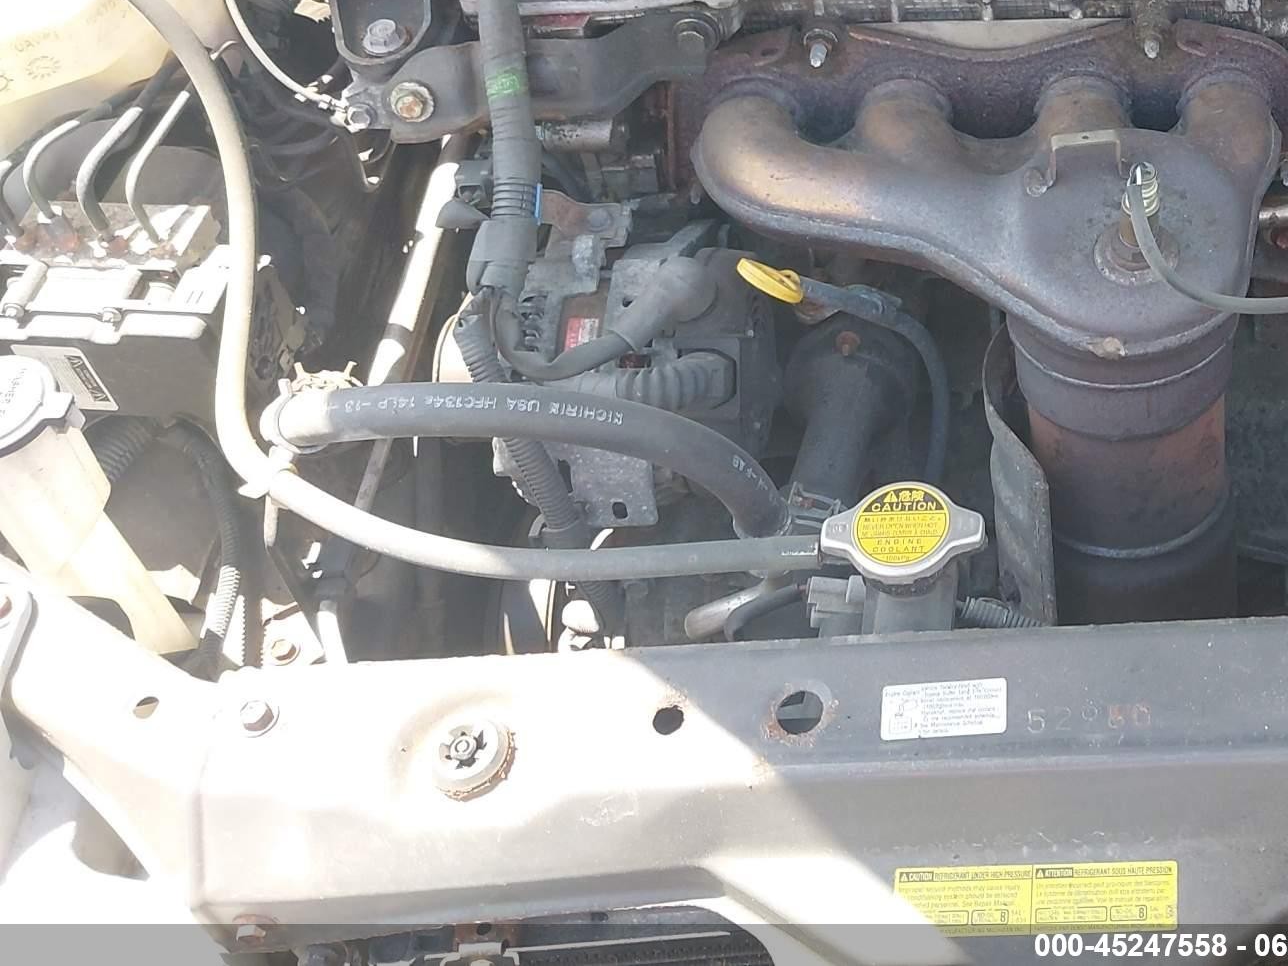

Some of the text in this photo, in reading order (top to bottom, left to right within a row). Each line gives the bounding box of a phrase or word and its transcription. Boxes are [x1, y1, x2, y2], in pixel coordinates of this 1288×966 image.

[505, 397, 540, 413] USA
[898, 490, 925, 503] 危険
[871, 501, 937, 513] CAUTION
[876, 538, 922, 546] ENGINE
[872, 545, 926, 553] COOLANT
[908, 872, 933, 881] CAUTION
[1003, 870, 1032, 878] PRESSURE
[1111, 867, 1126, 875] SOUS
[1145, 866, 1172, 874] PRESSION
[1000, 911, 1006, 923] 8
[1138, 907, 1145, 919] 8
